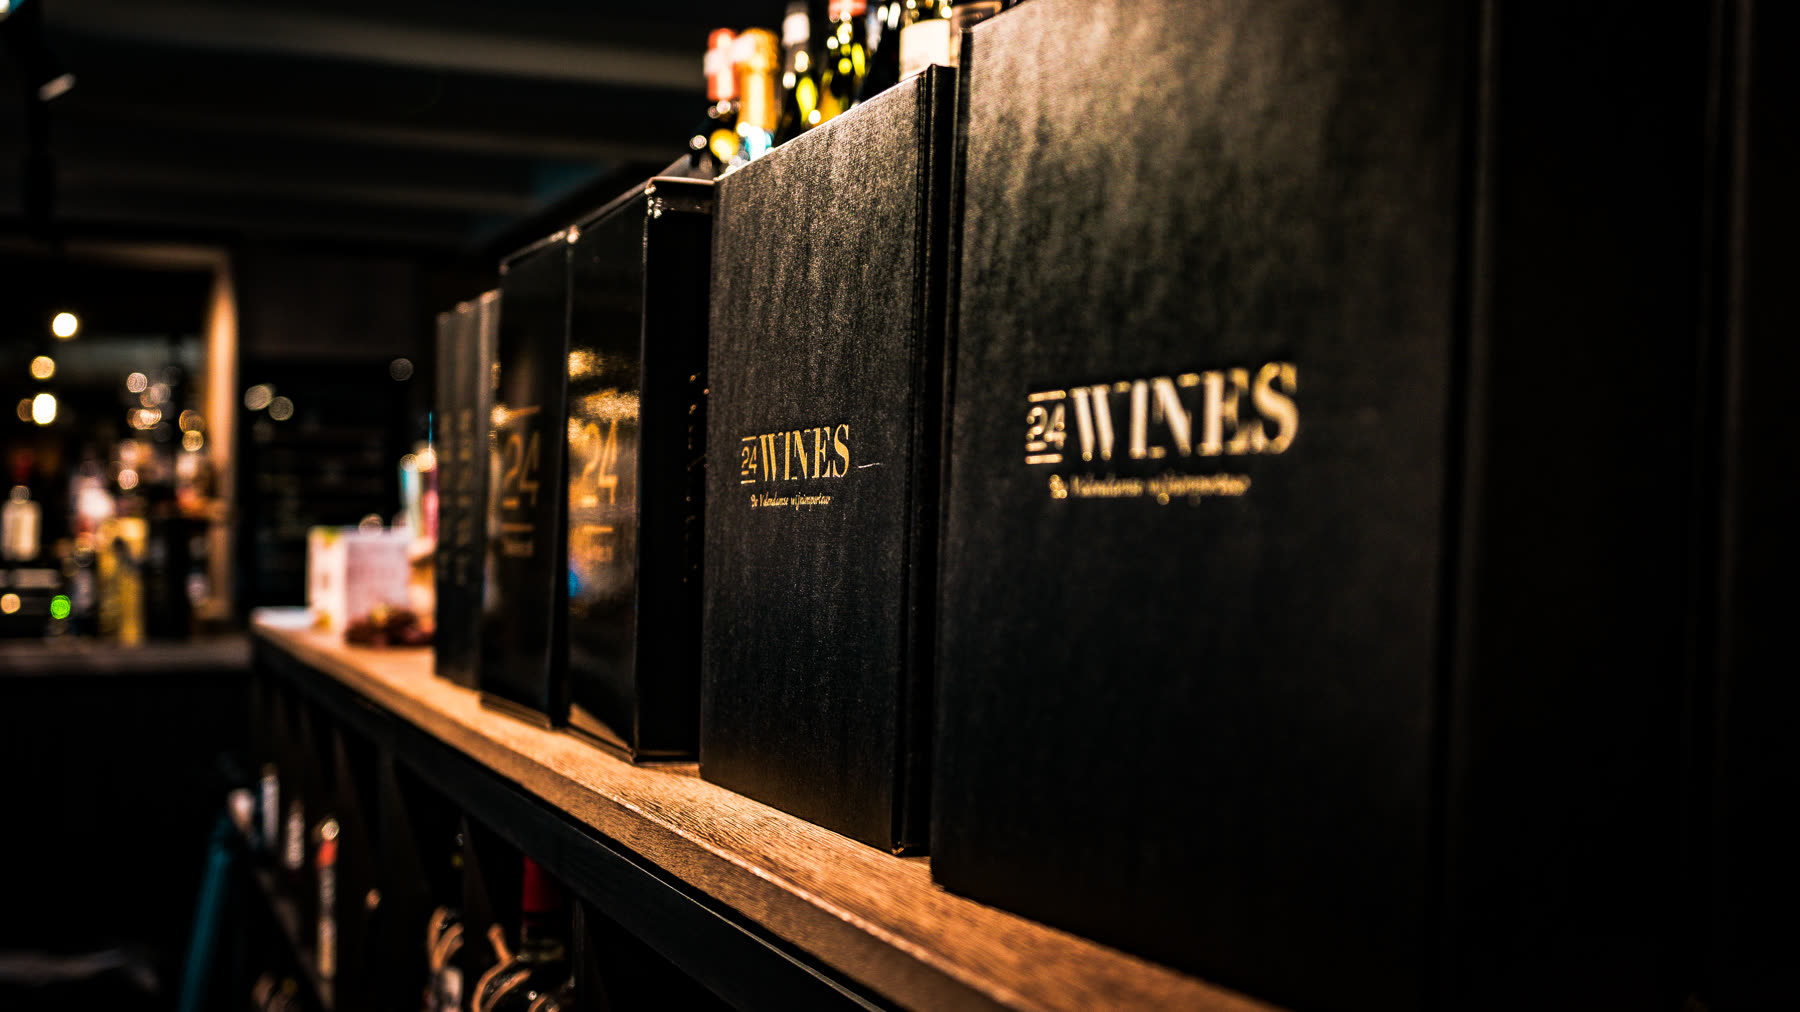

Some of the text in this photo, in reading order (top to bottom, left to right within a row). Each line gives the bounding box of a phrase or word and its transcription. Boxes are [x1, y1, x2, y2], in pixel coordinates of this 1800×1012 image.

[741, 424, 850, 482] 24 WINES
[1026, 361, 1299, 462] 24 WINES
[580, 419, 618, 508] 24
